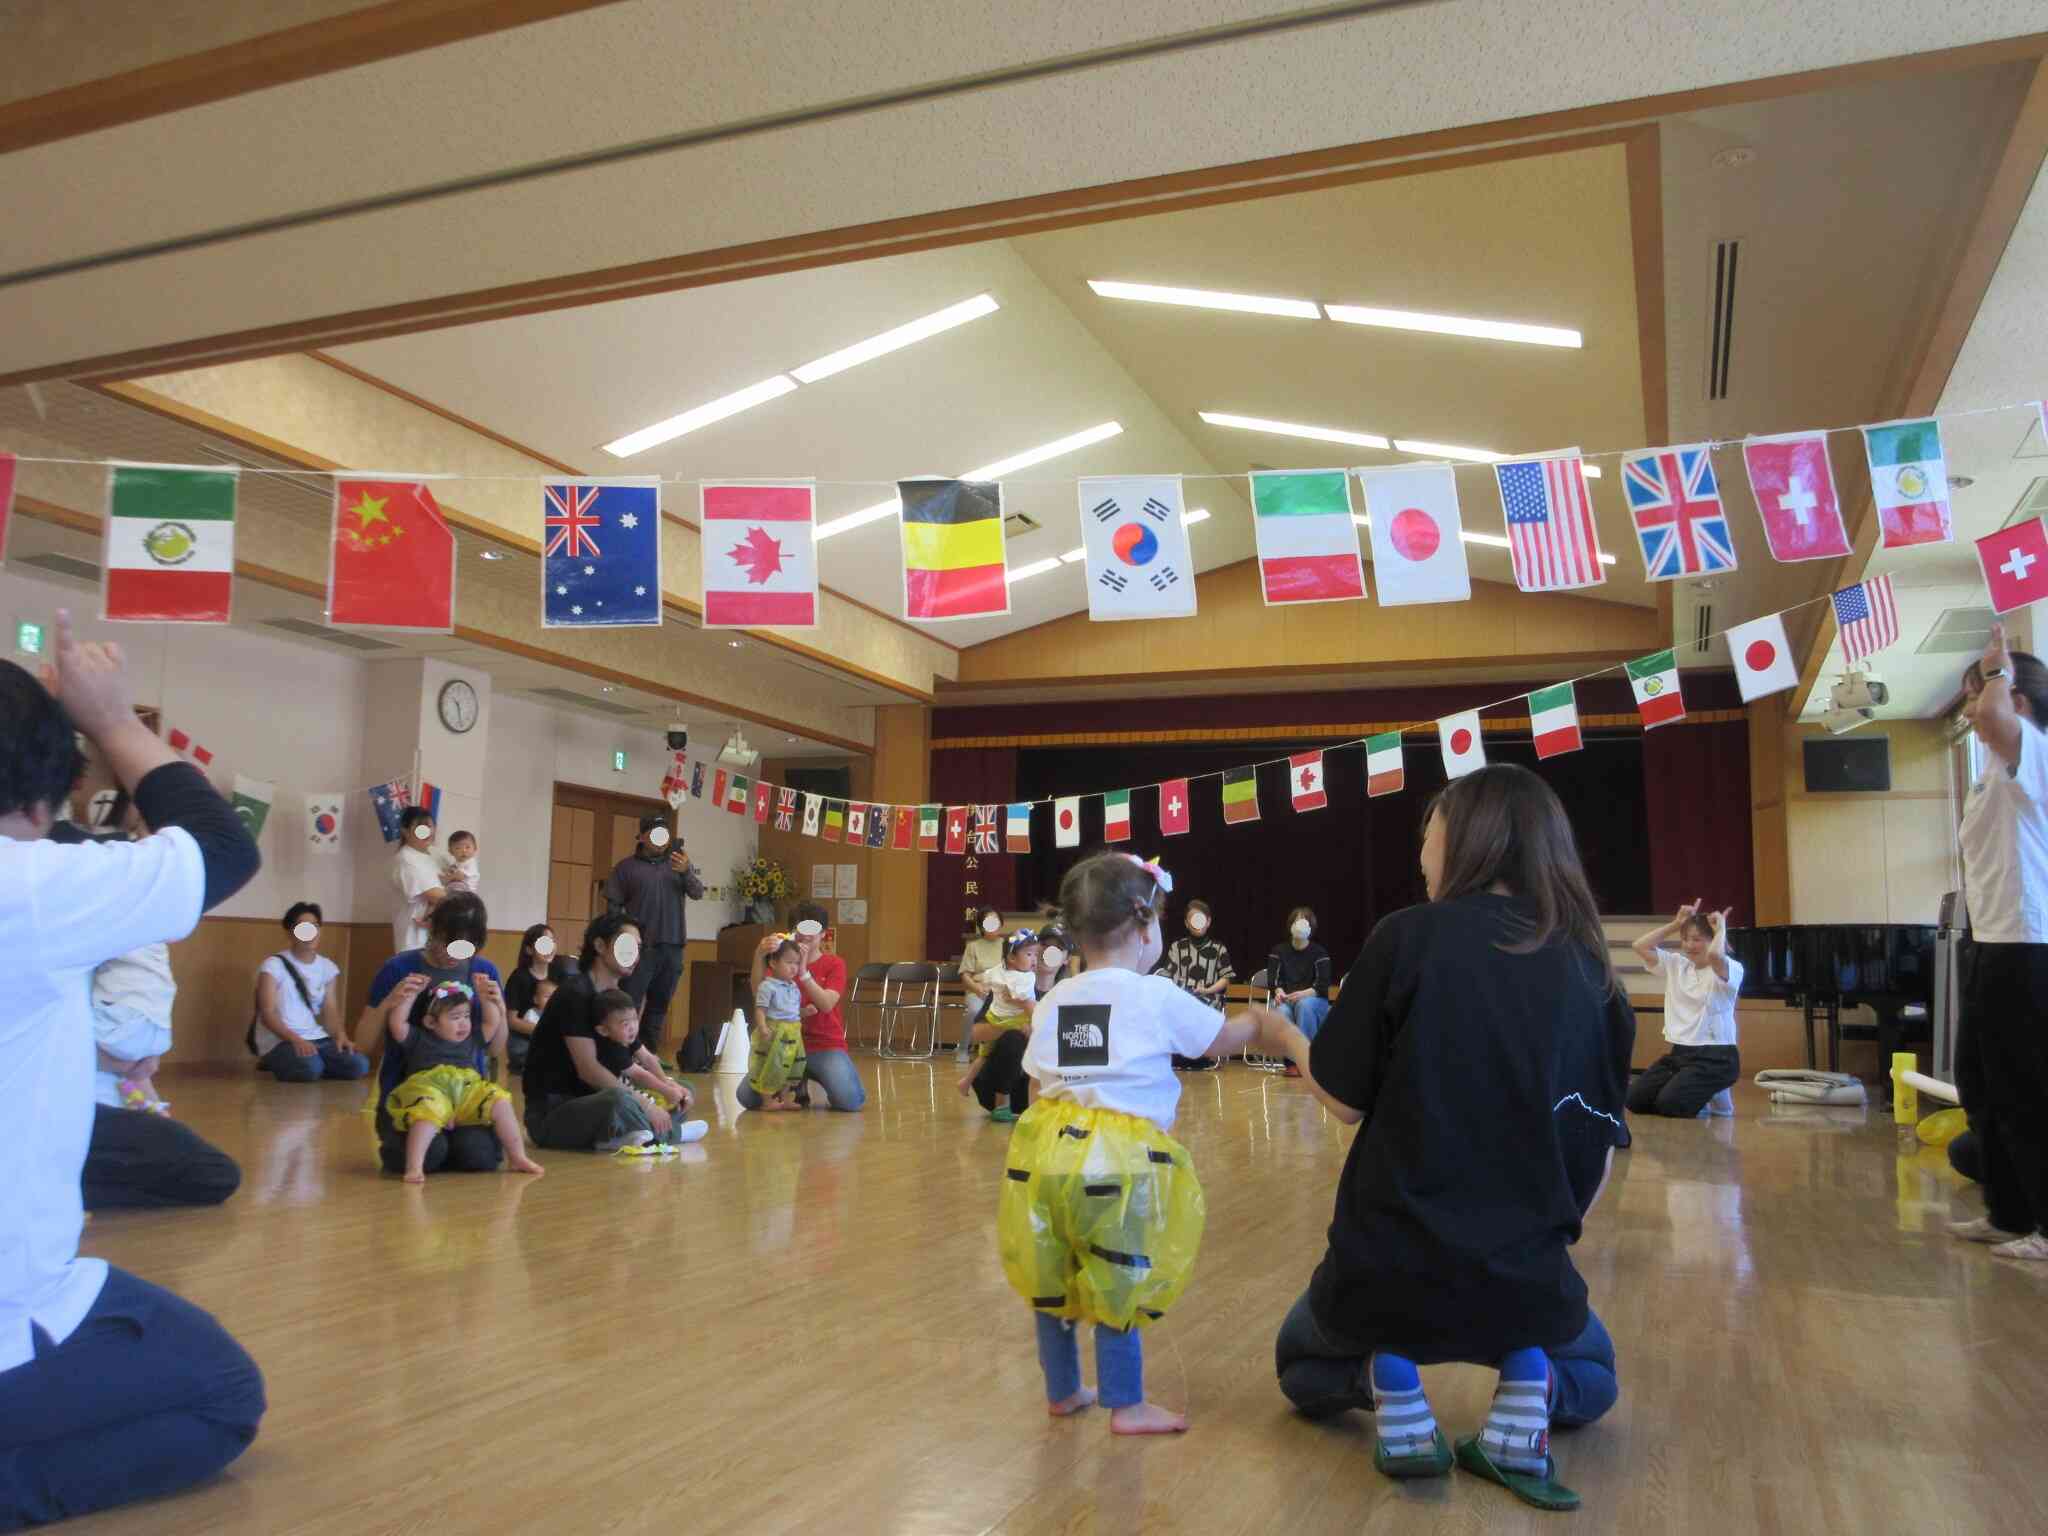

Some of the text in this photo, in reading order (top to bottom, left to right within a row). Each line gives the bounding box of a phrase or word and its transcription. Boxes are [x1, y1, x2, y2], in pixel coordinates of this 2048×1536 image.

[1074, 1024, 1089, 1032] THE
[1062, 1031, 1089, 1041] NORTH
[1070, 1040, 1089, 1048] FACE
